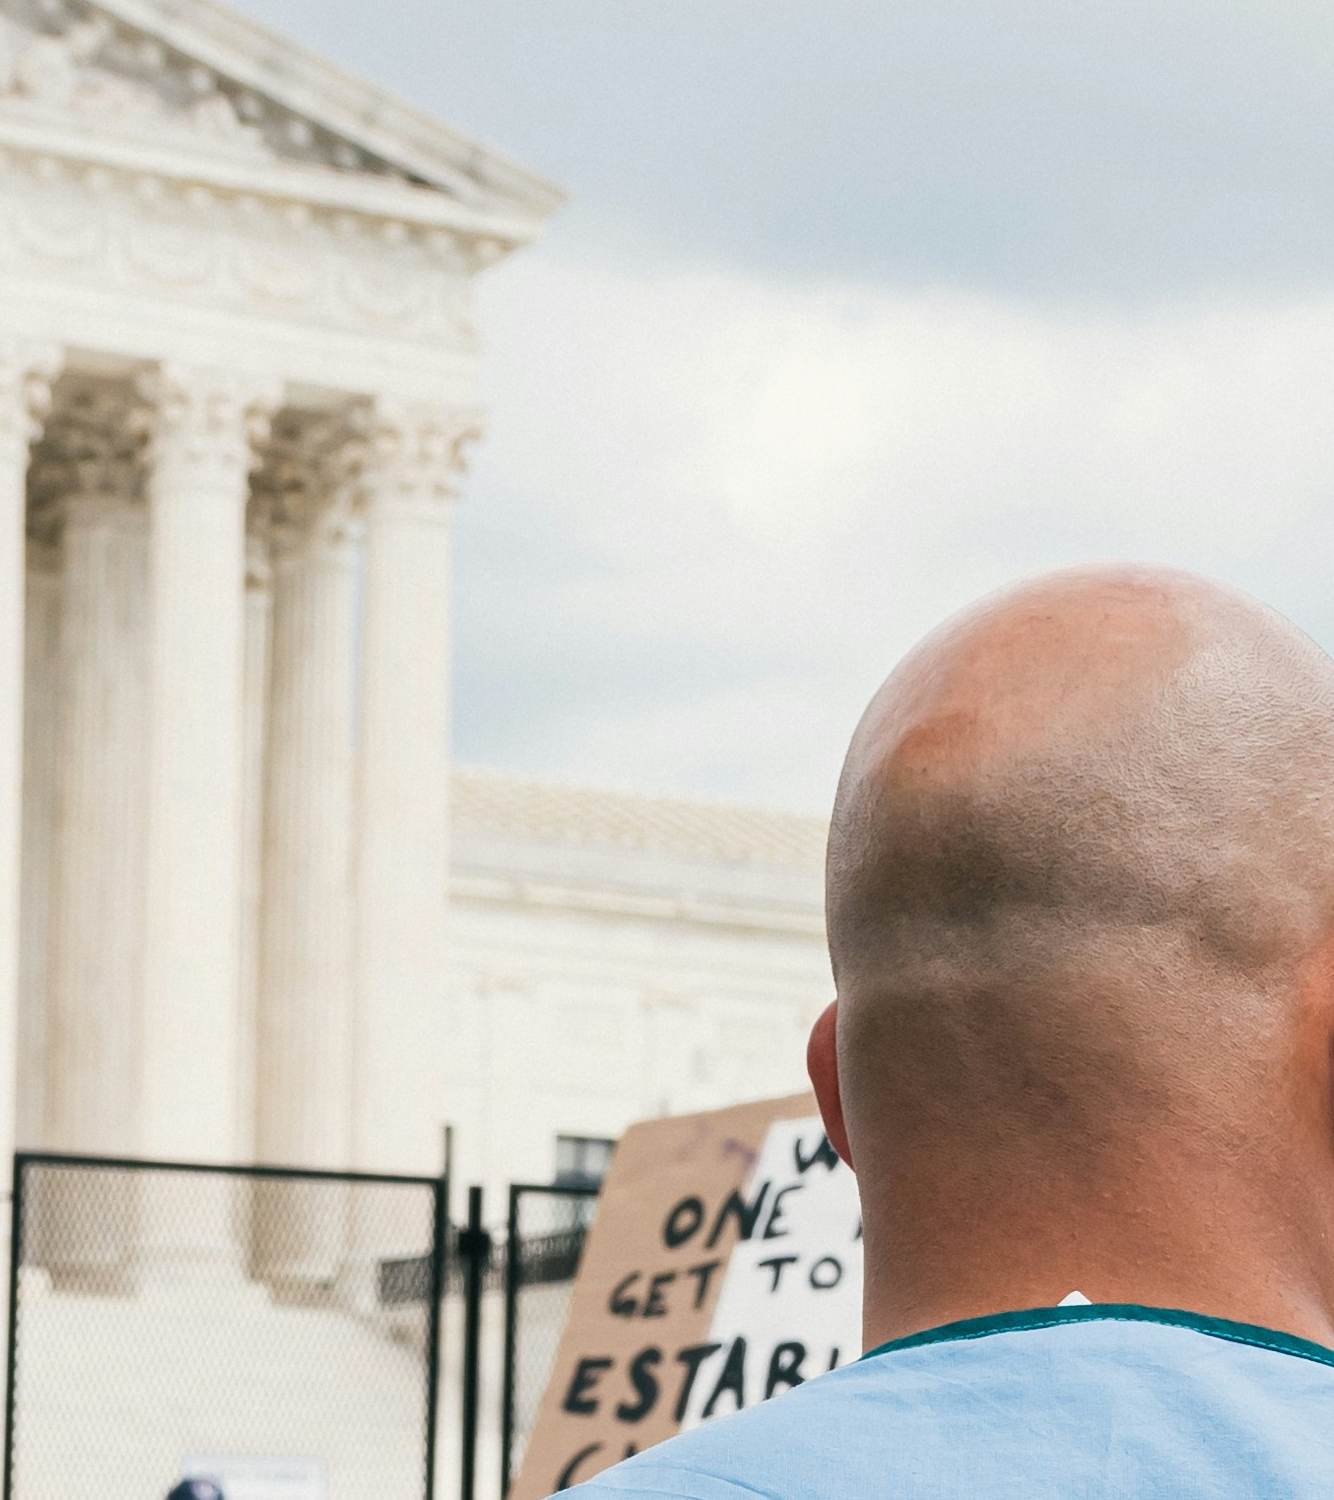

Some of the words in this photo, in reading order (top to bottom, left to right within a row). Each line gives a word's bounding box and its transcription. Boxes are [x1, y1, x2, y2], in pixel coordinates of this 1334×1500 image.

[663, 1180, 804, 1249] ONE
[608, 1260, 723, 1319] GET
[758, 1256, 844, 1291] TO
